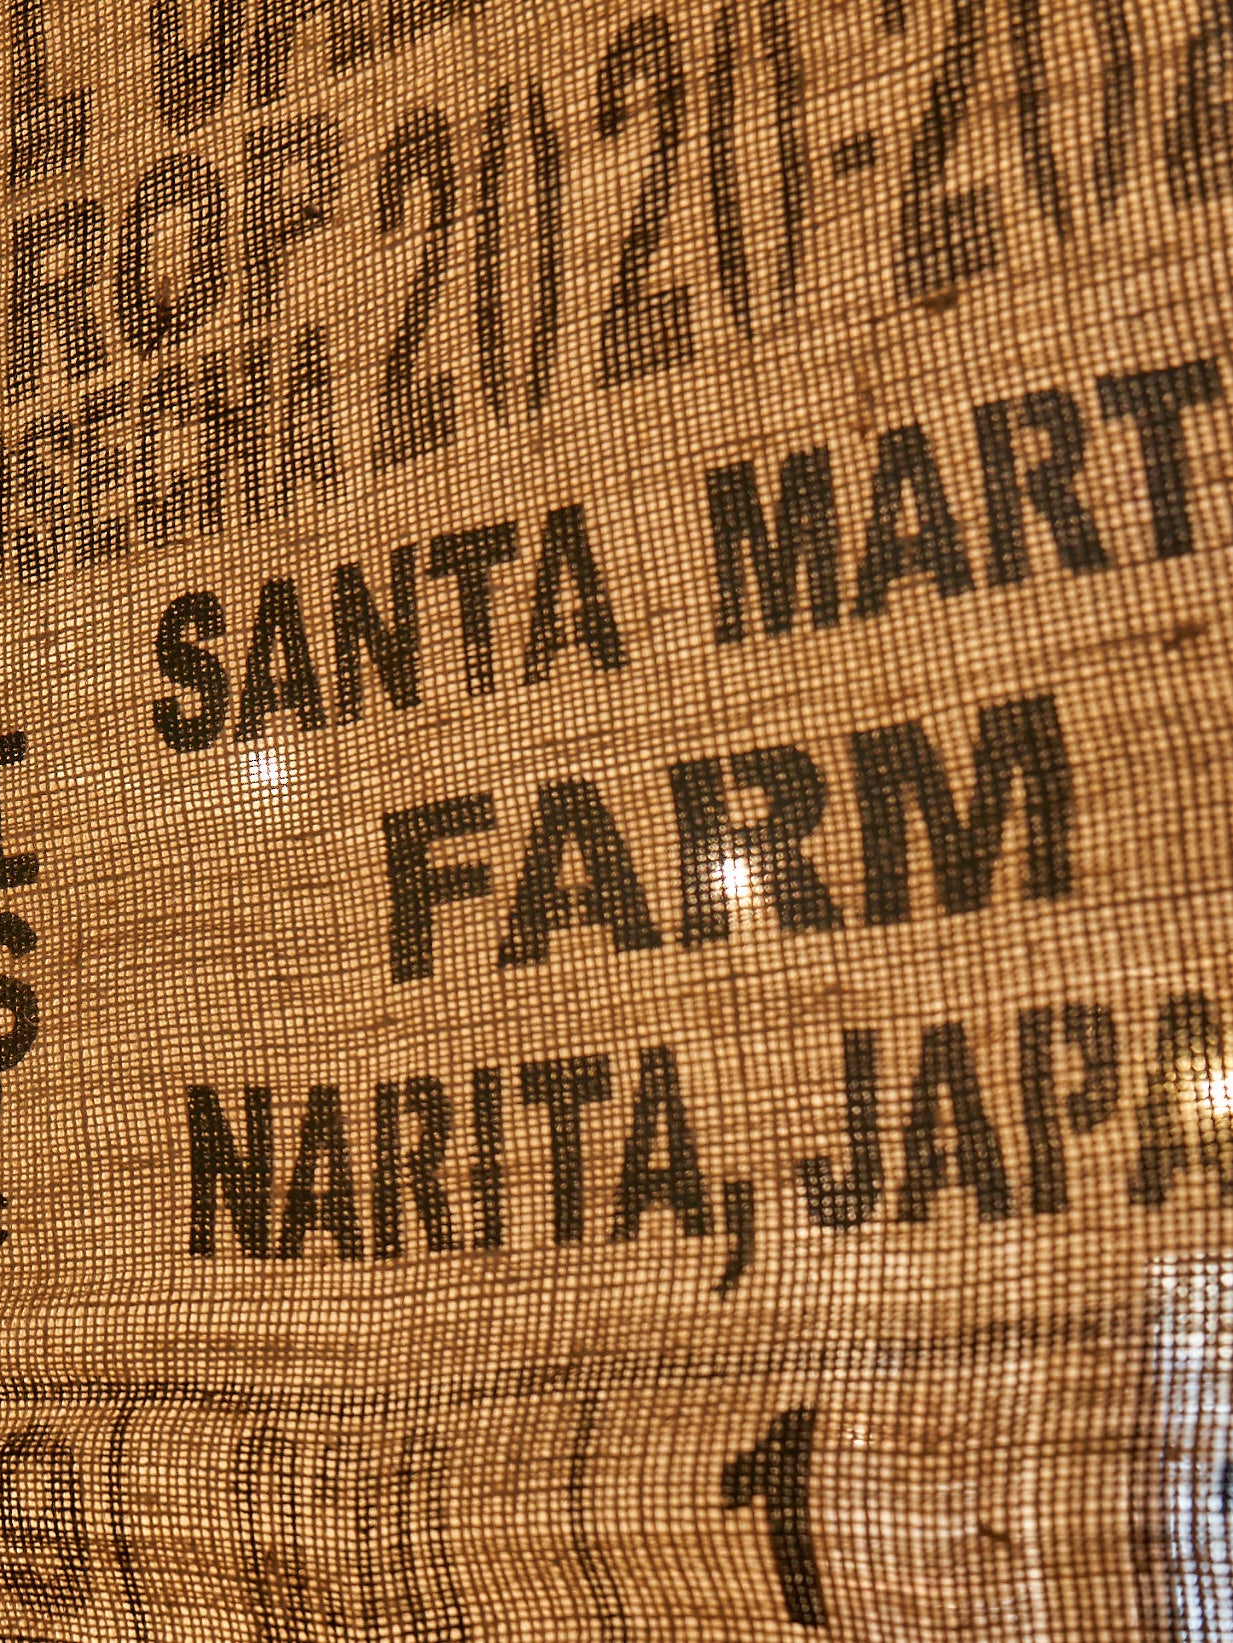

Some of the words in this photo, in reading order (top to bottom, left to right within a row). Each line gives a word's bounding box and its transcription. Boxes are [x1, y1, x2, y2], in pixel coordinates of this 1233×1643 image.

[154, 502, 624, 752] SANTA
[705, 357, 1225, 646] MART
[384, 695, 1074, 984] FARM
[186, 1043, 758, 1300] NARITA,
[720, 1404, 830, 1632] 1
